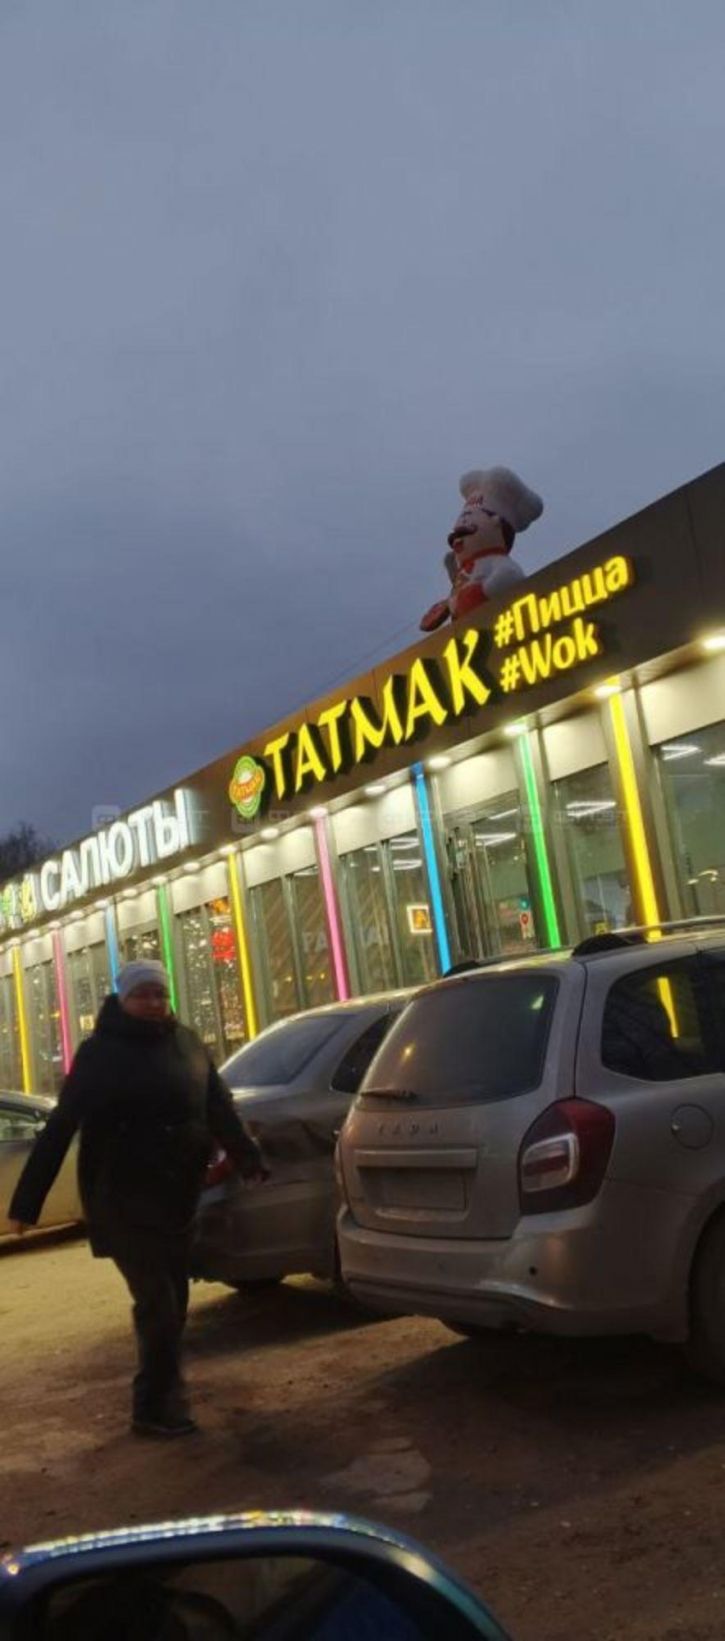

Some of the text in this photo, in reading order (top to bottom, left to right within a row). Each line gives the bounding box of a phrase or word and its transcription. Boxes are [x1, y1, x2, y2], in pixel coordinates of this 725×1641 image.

[493, 555, 630, 648] #Пицца
[500, 618, 599, 692] #Wok
[263, 628, 491, 800] ТАТМАК
[41, 788, 189, 911] САЛЮТЫ
